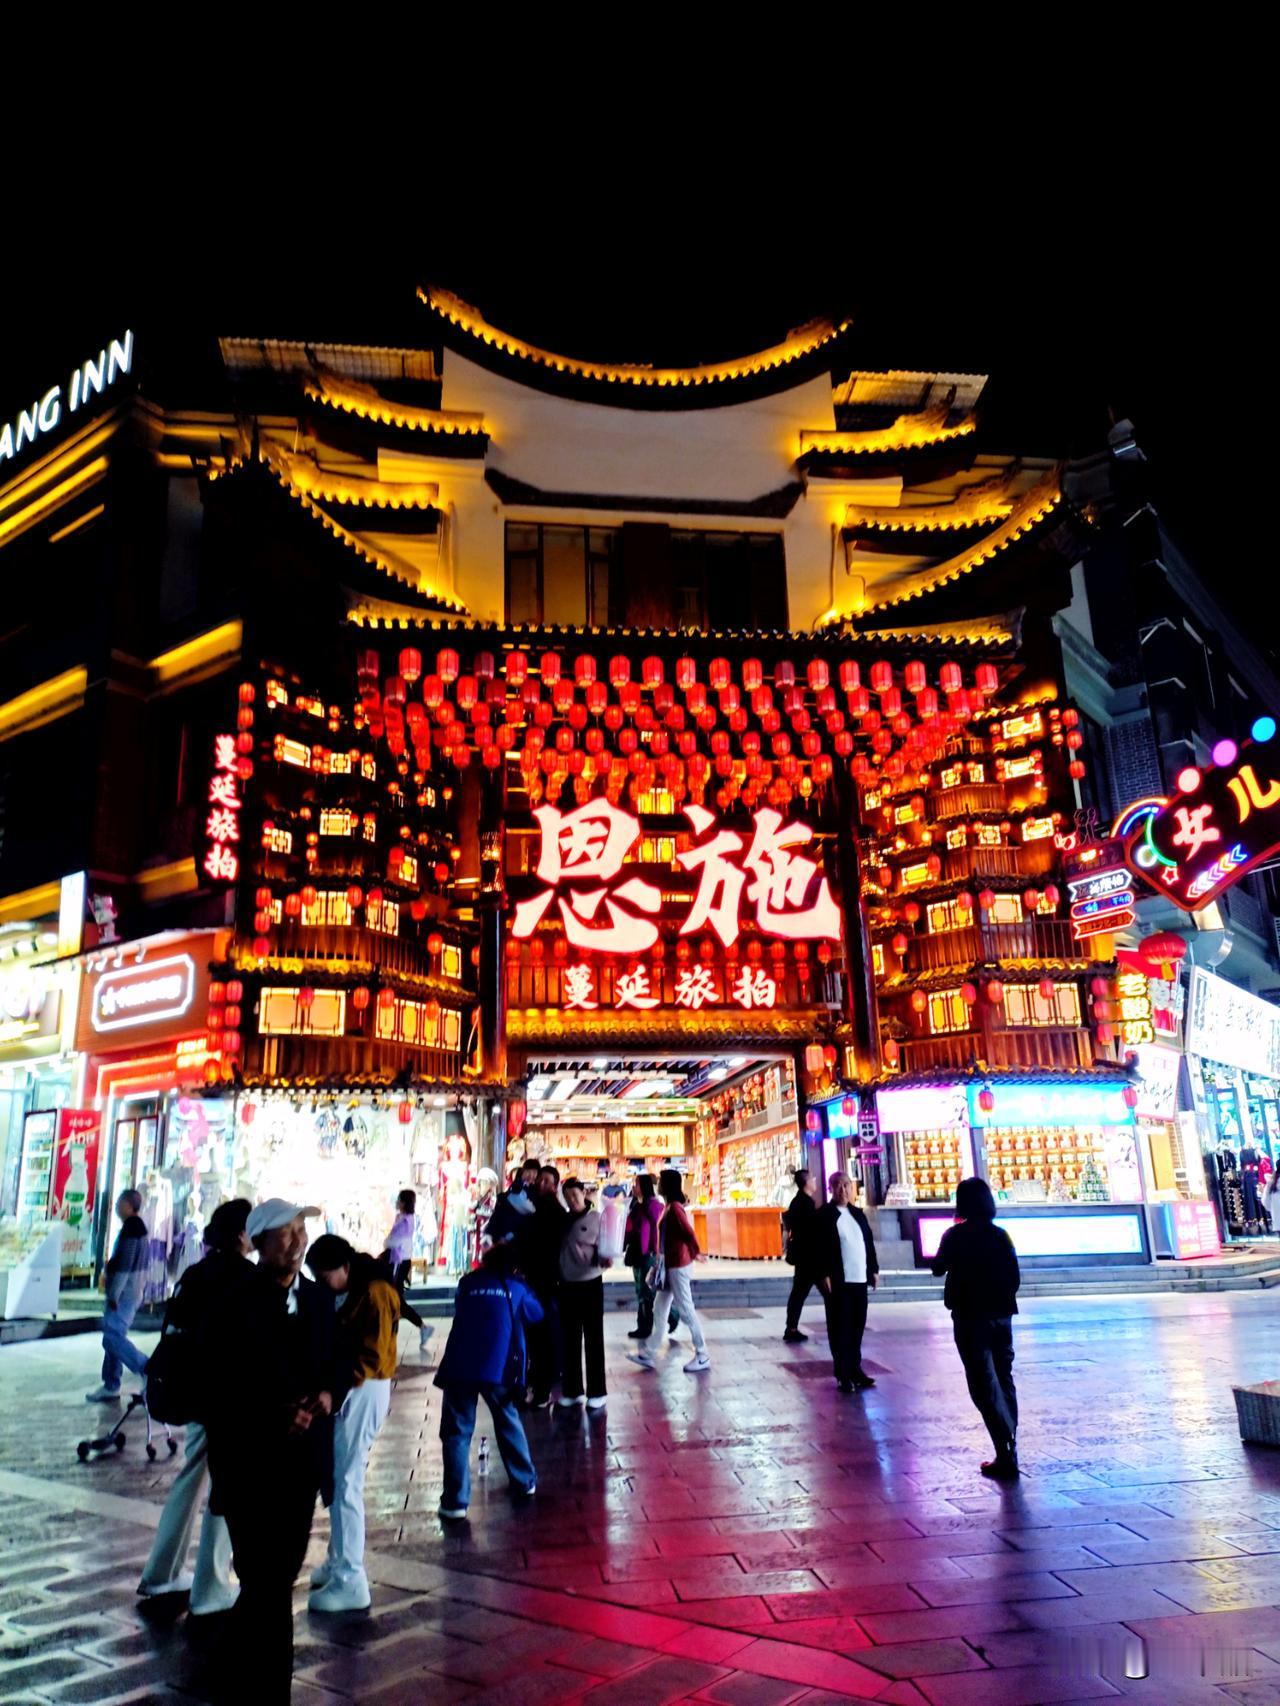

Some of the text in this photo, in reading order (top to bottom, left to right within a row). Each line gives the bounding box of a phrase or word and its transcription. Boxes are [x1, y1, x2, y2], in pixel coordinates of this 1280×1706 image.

[0, 330, 134, 462] ANG INN
[1173, 765, 1280, 863] 女儿
[512, 797, 842, 953] 恩施
[564, 963, 776, 1010] 蔓延旅拍
[1118, 973, 1153, 1045] 老酸奶
[558, 1134, 588, 1150] 特产
[640, 1134, 669, 1148] 文创
